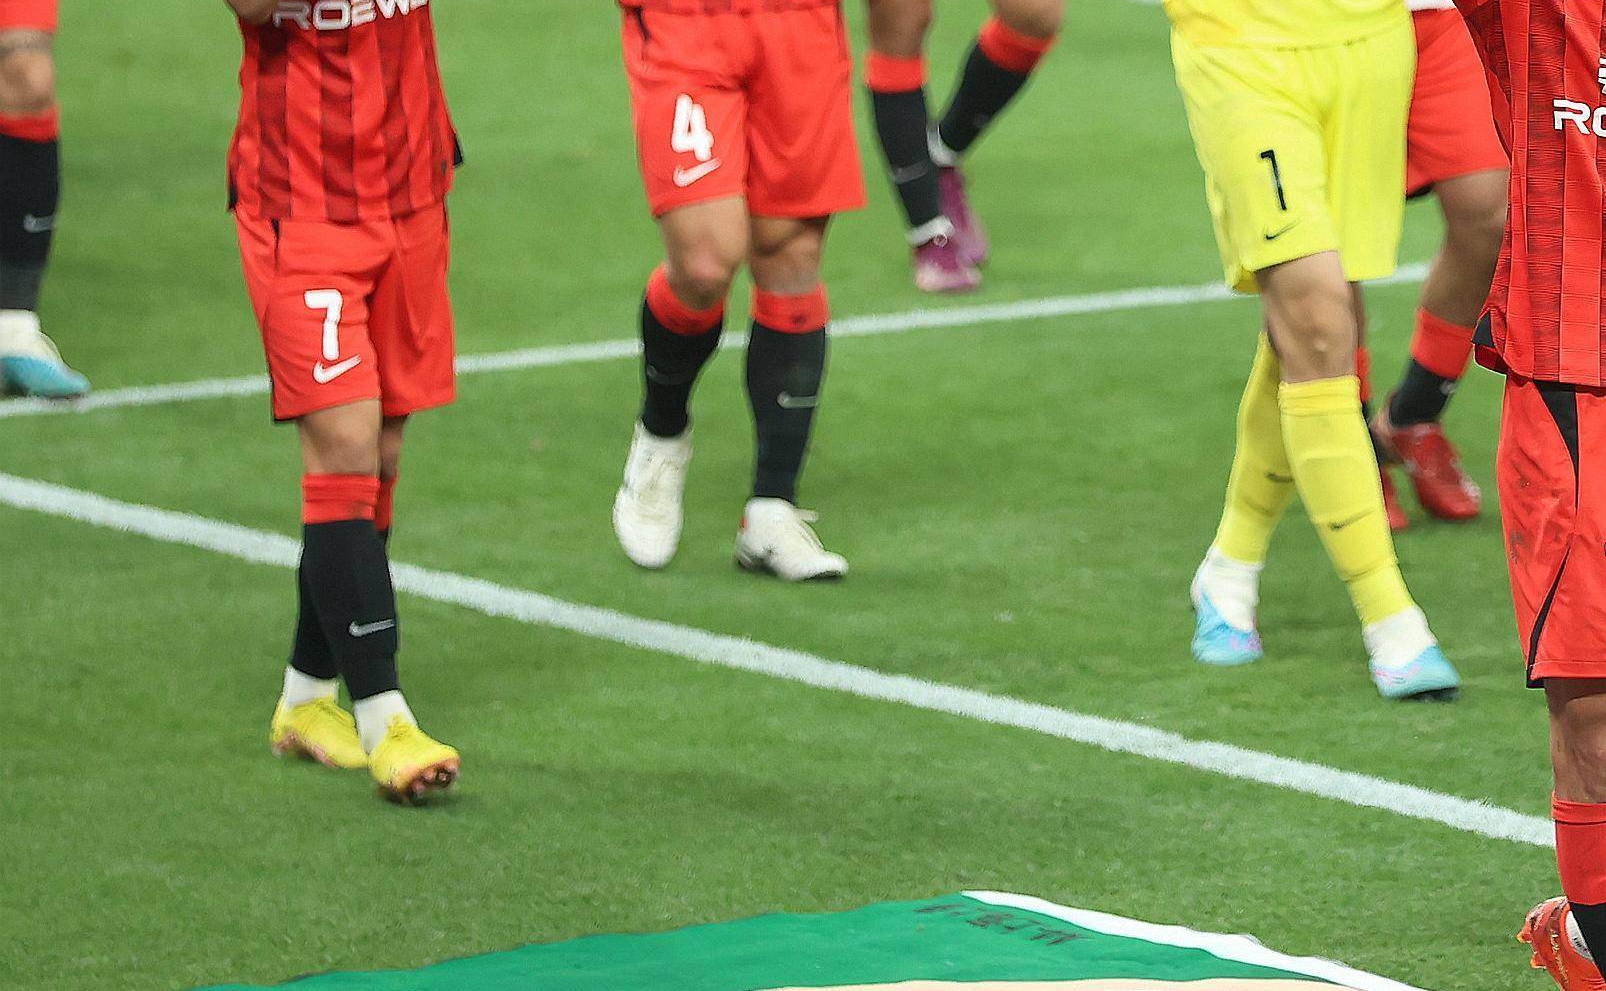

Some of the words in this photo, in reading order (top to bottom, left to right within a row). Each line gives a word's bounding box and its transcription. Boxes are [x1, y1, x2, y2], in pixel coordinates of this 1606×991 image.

[671, 94, 714, 162] 4
[1260, 150, 1287, 211] 1
[303, 288, 343, 361] 7
